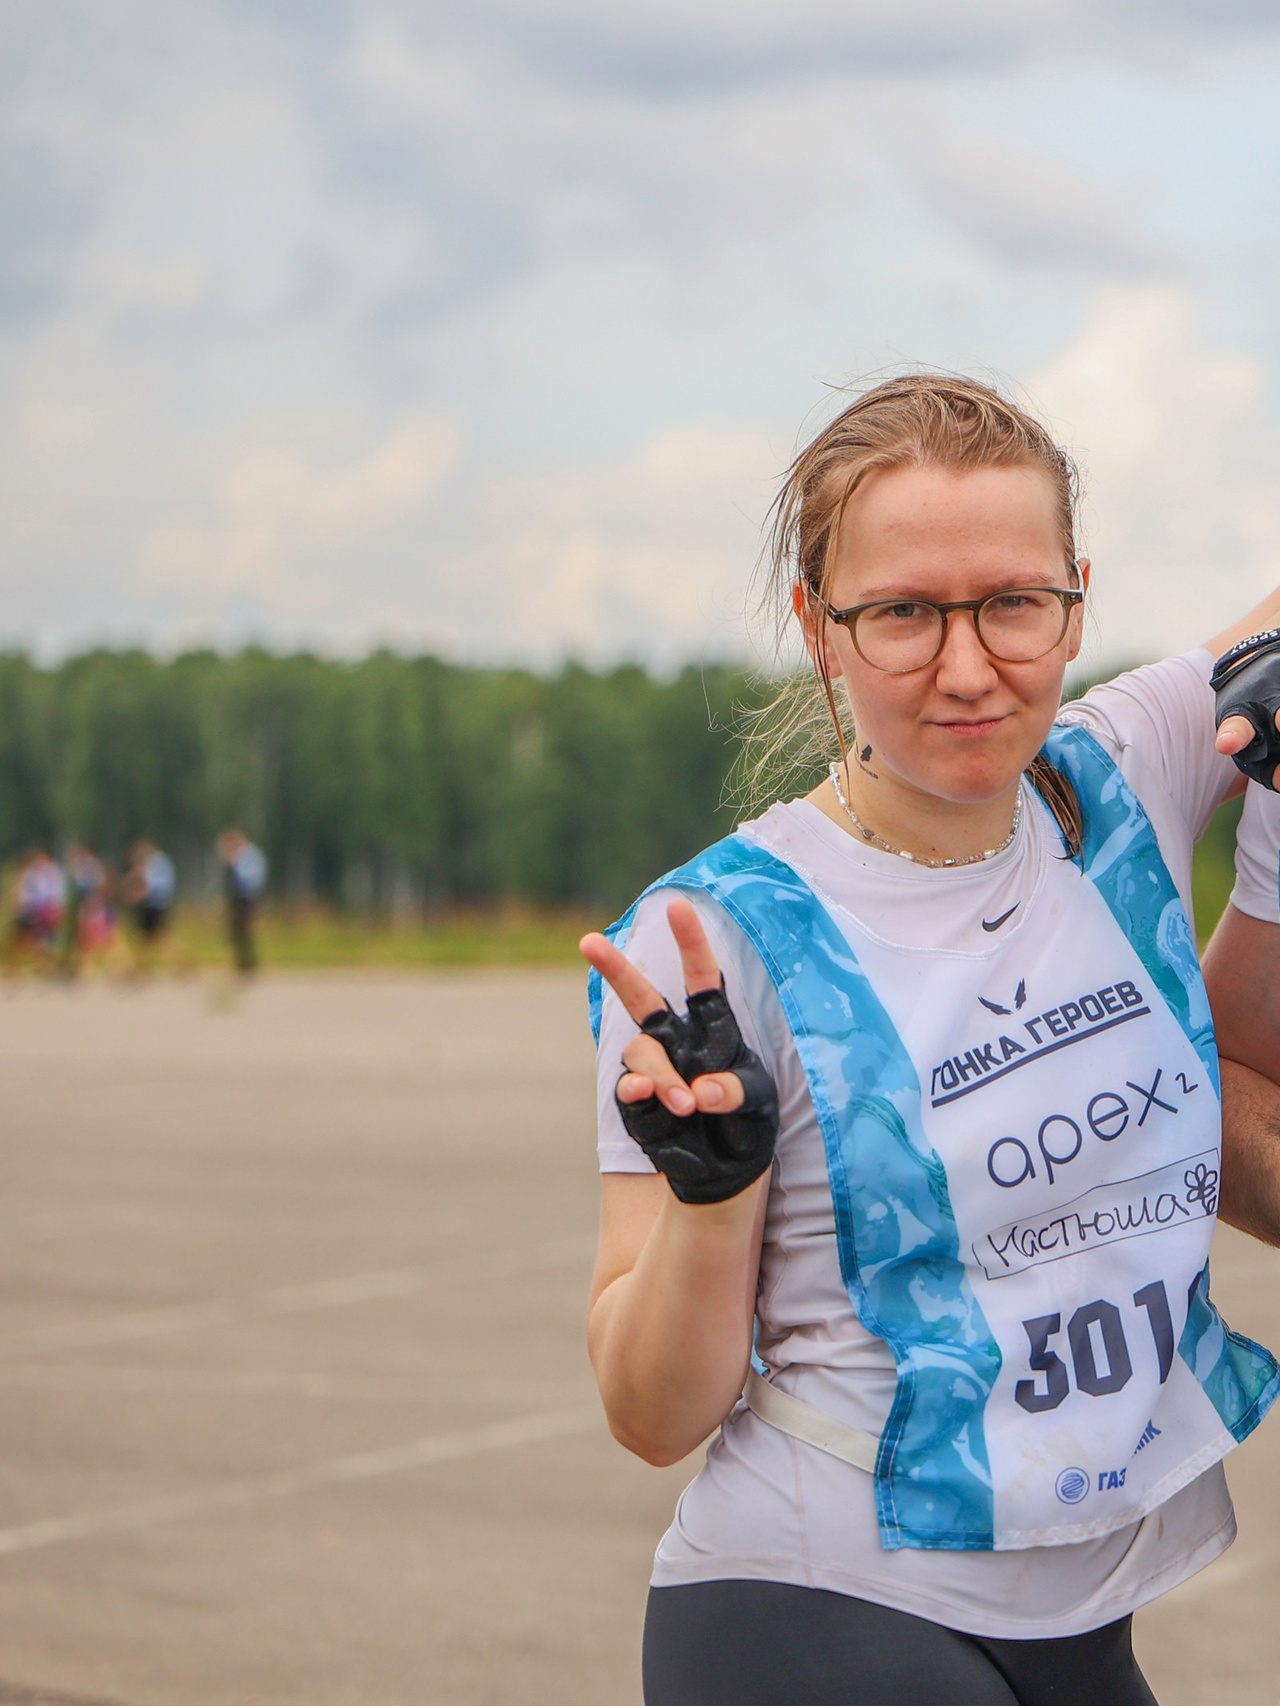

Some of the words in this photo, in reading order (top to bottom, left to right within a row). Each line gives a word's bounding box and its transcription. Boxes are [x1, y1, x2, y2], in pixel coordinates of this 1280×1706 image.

[930, 1035, 1027, 1096] ГОНКА
[1023, 979, 1144, 1045] ГЕРОЕВ
[987, 1067, 1179, 1188] apex
[1014, 1271, 1204, 1414] 501
